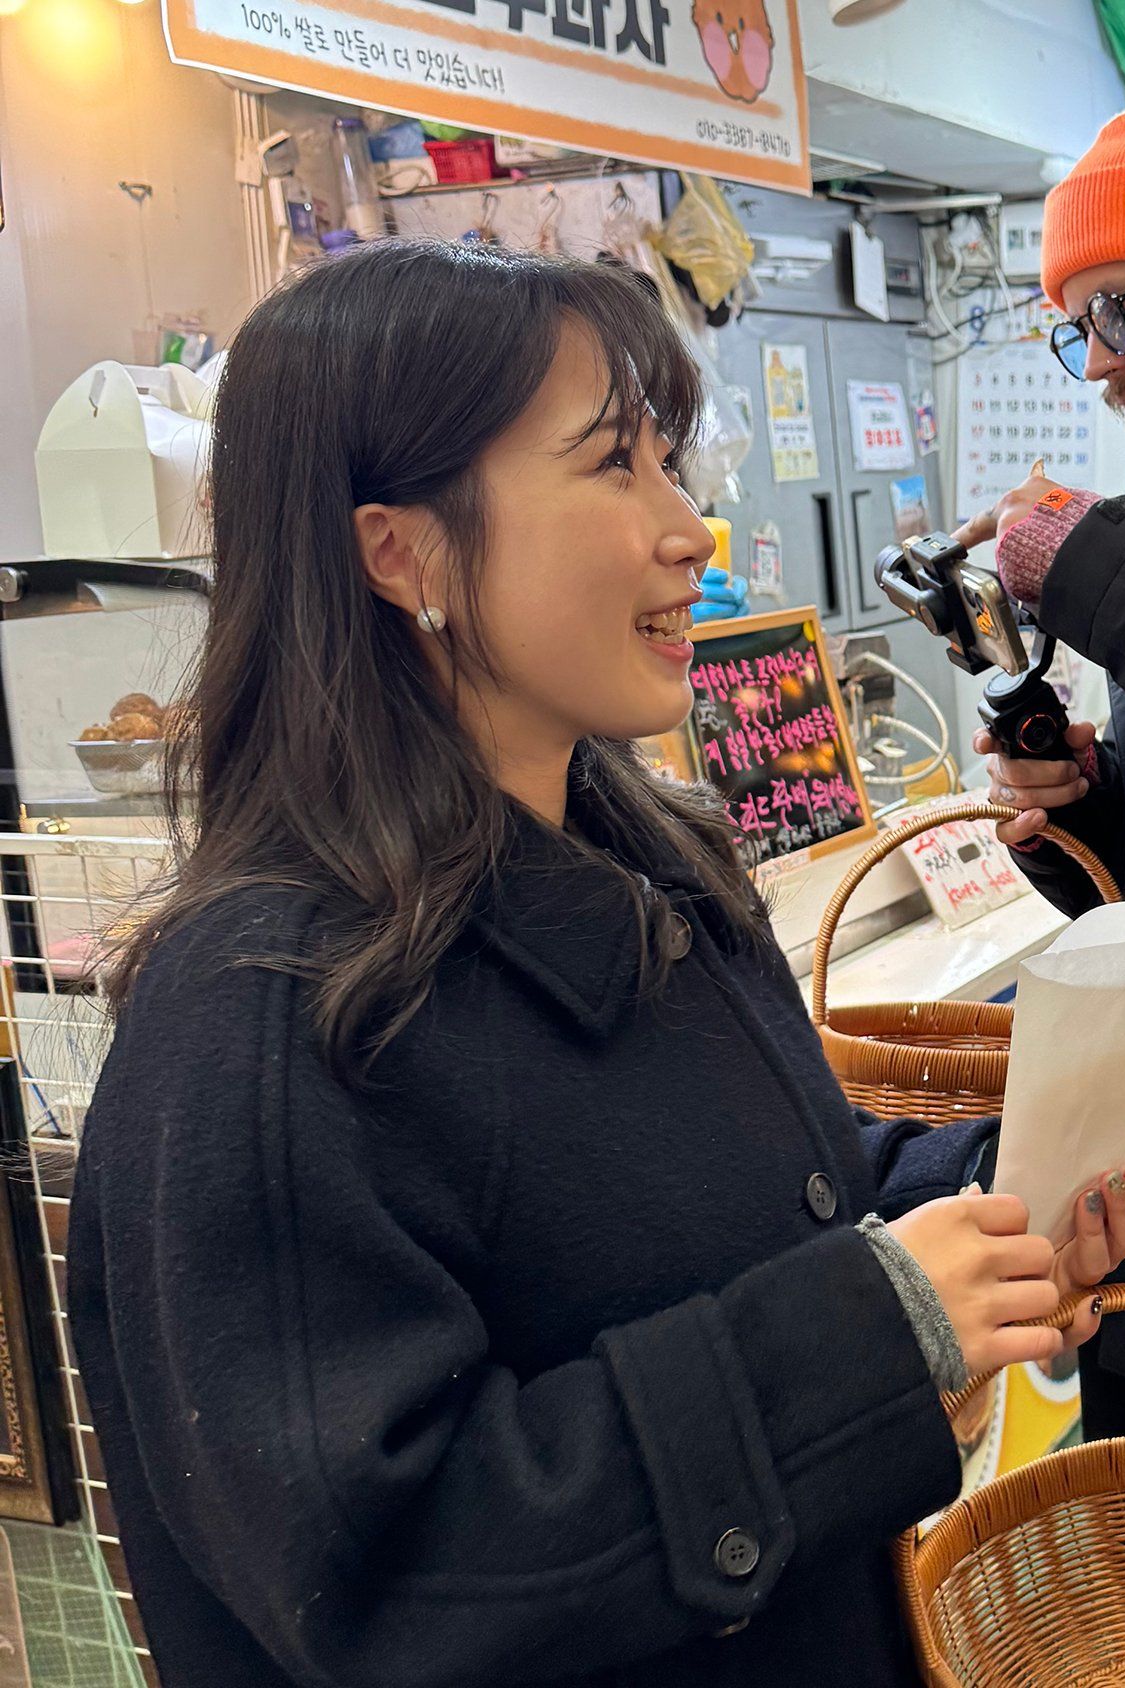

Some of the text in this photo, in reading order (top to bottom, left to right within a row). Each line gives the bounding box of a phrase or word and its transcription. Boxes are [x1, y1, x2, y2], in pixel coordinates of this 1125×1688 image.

[241, 3, 506, 94] 100% 쌀로 만들어 더 맛있습니다!
